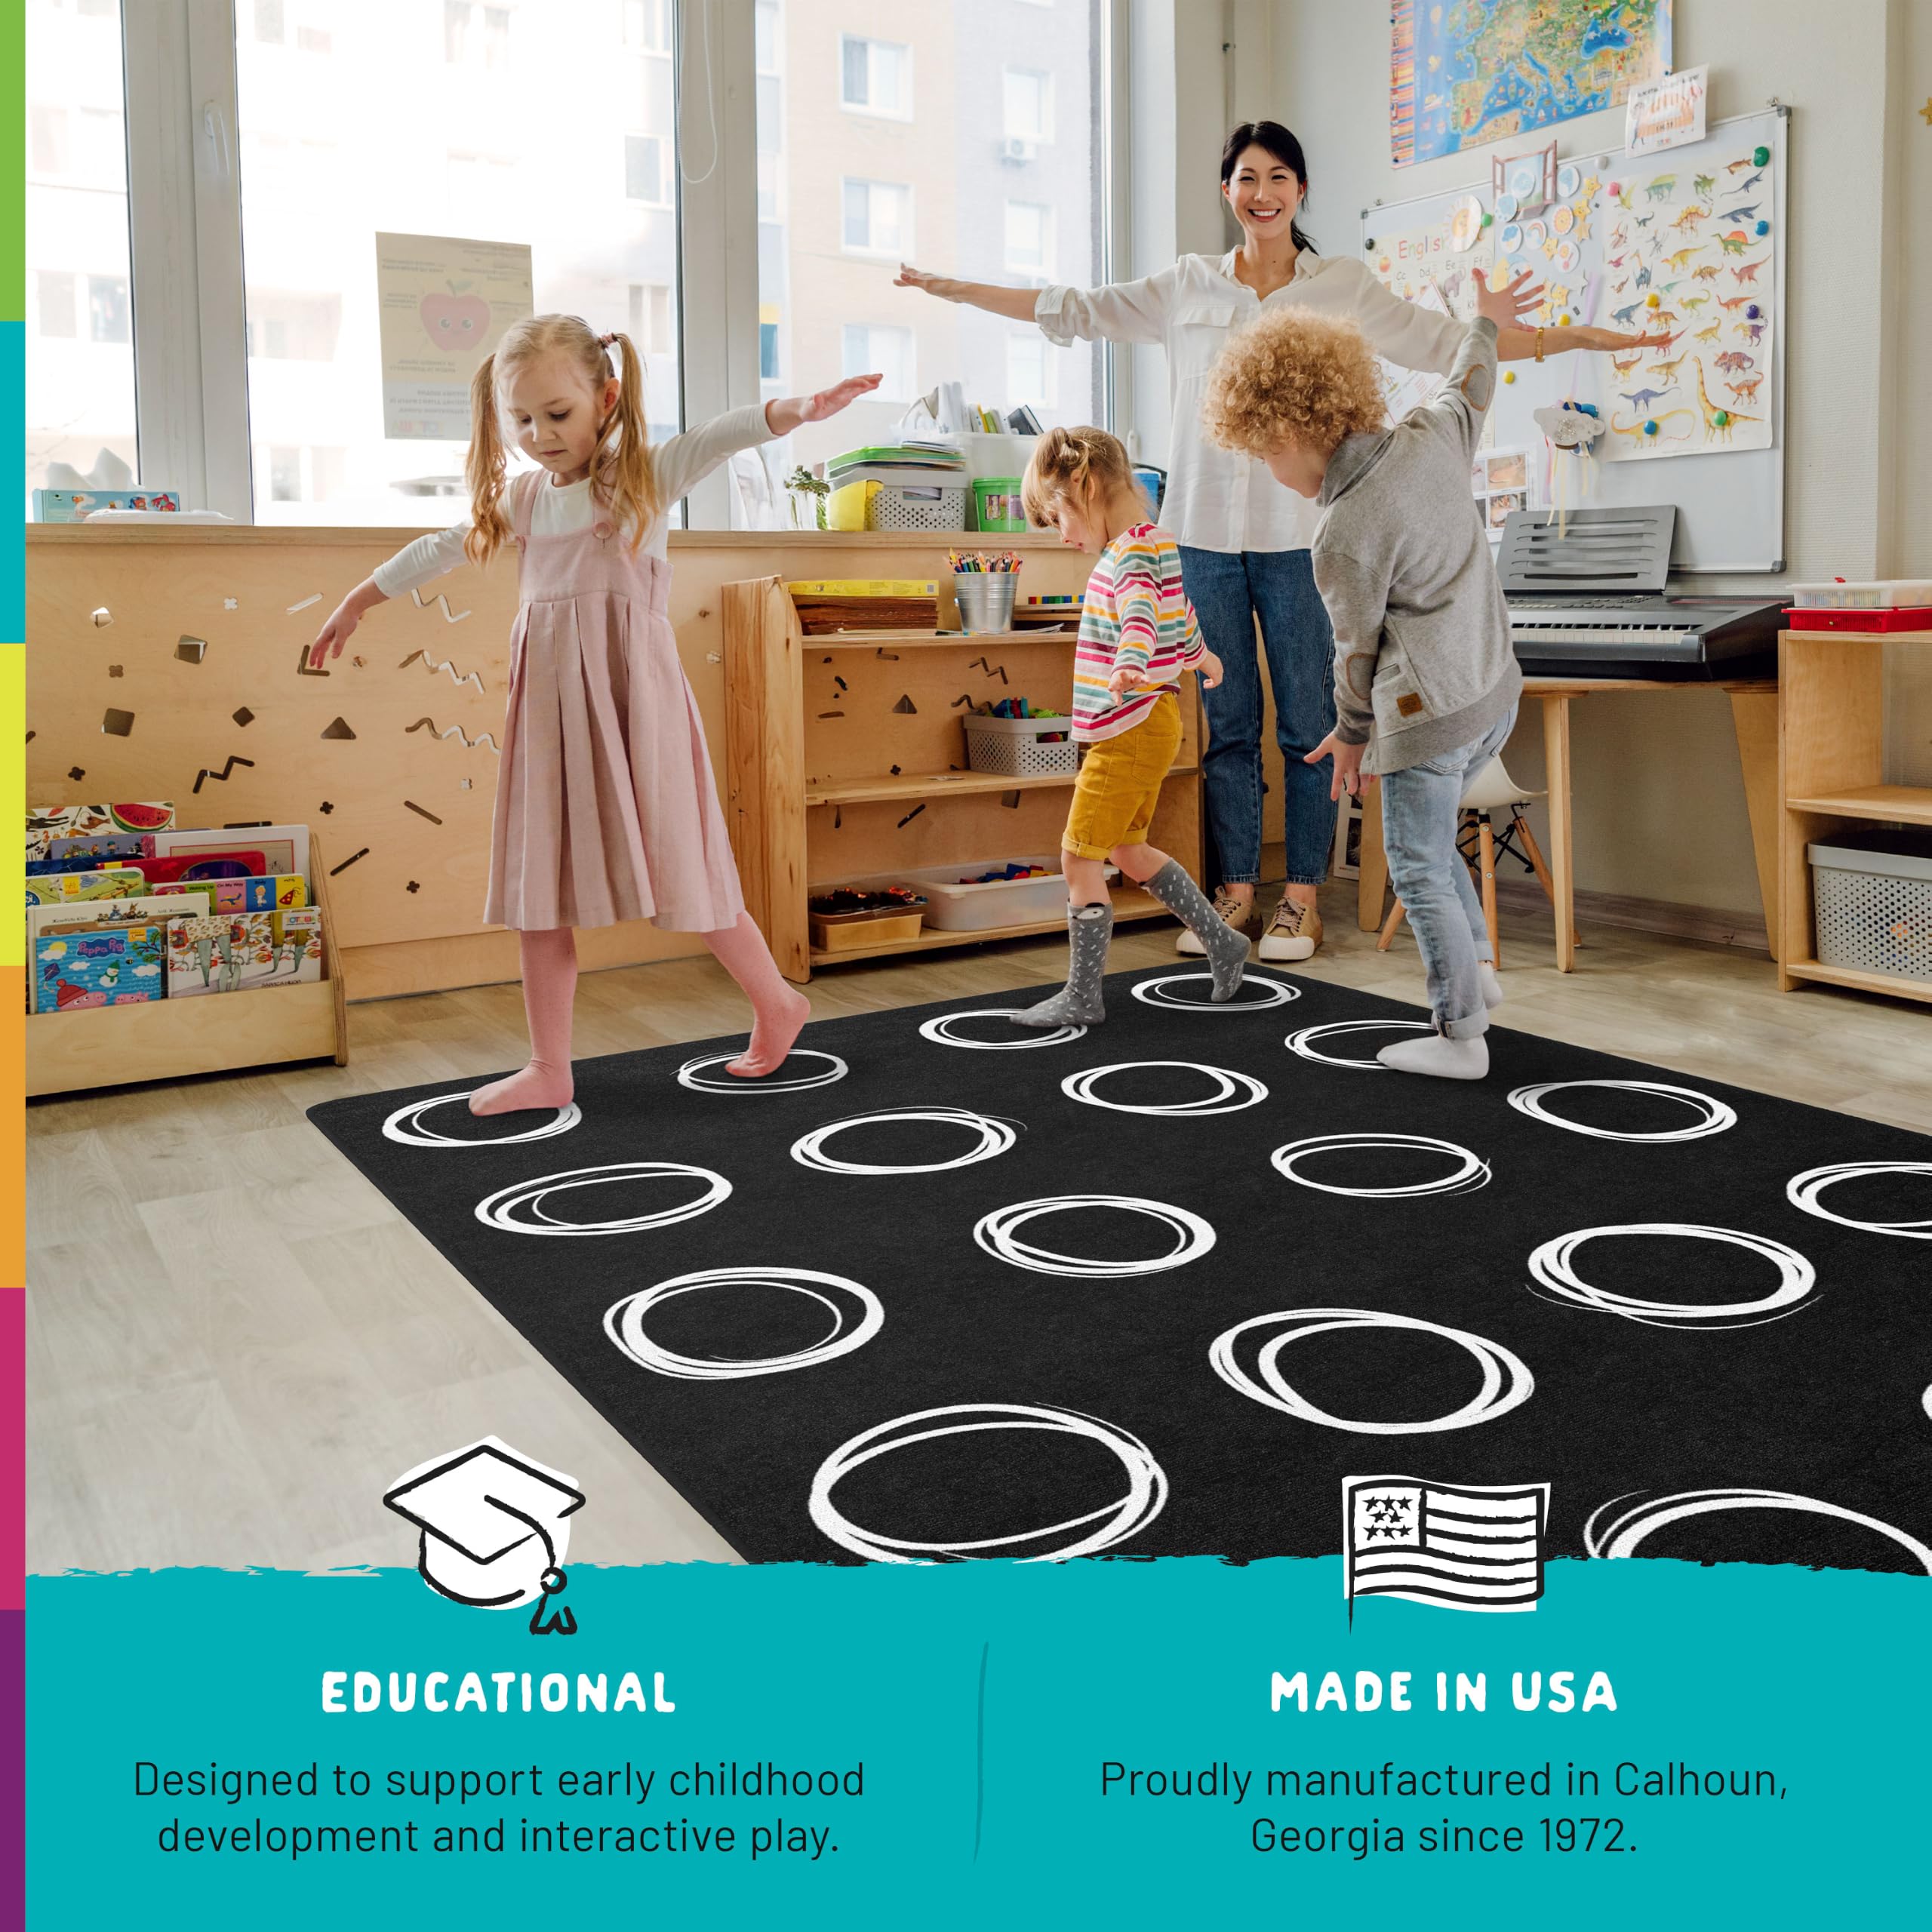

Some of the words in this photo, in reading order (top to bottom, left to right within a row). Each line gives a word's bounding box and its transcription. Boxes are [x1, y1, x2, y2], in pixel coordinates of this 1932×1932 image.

[1396, 271, 1406, 280] Cc
[1419, 266, 1431, 278] Dd
[78, 941, 108, 957] Peppa
[109, 939, 124, 952] Pig
